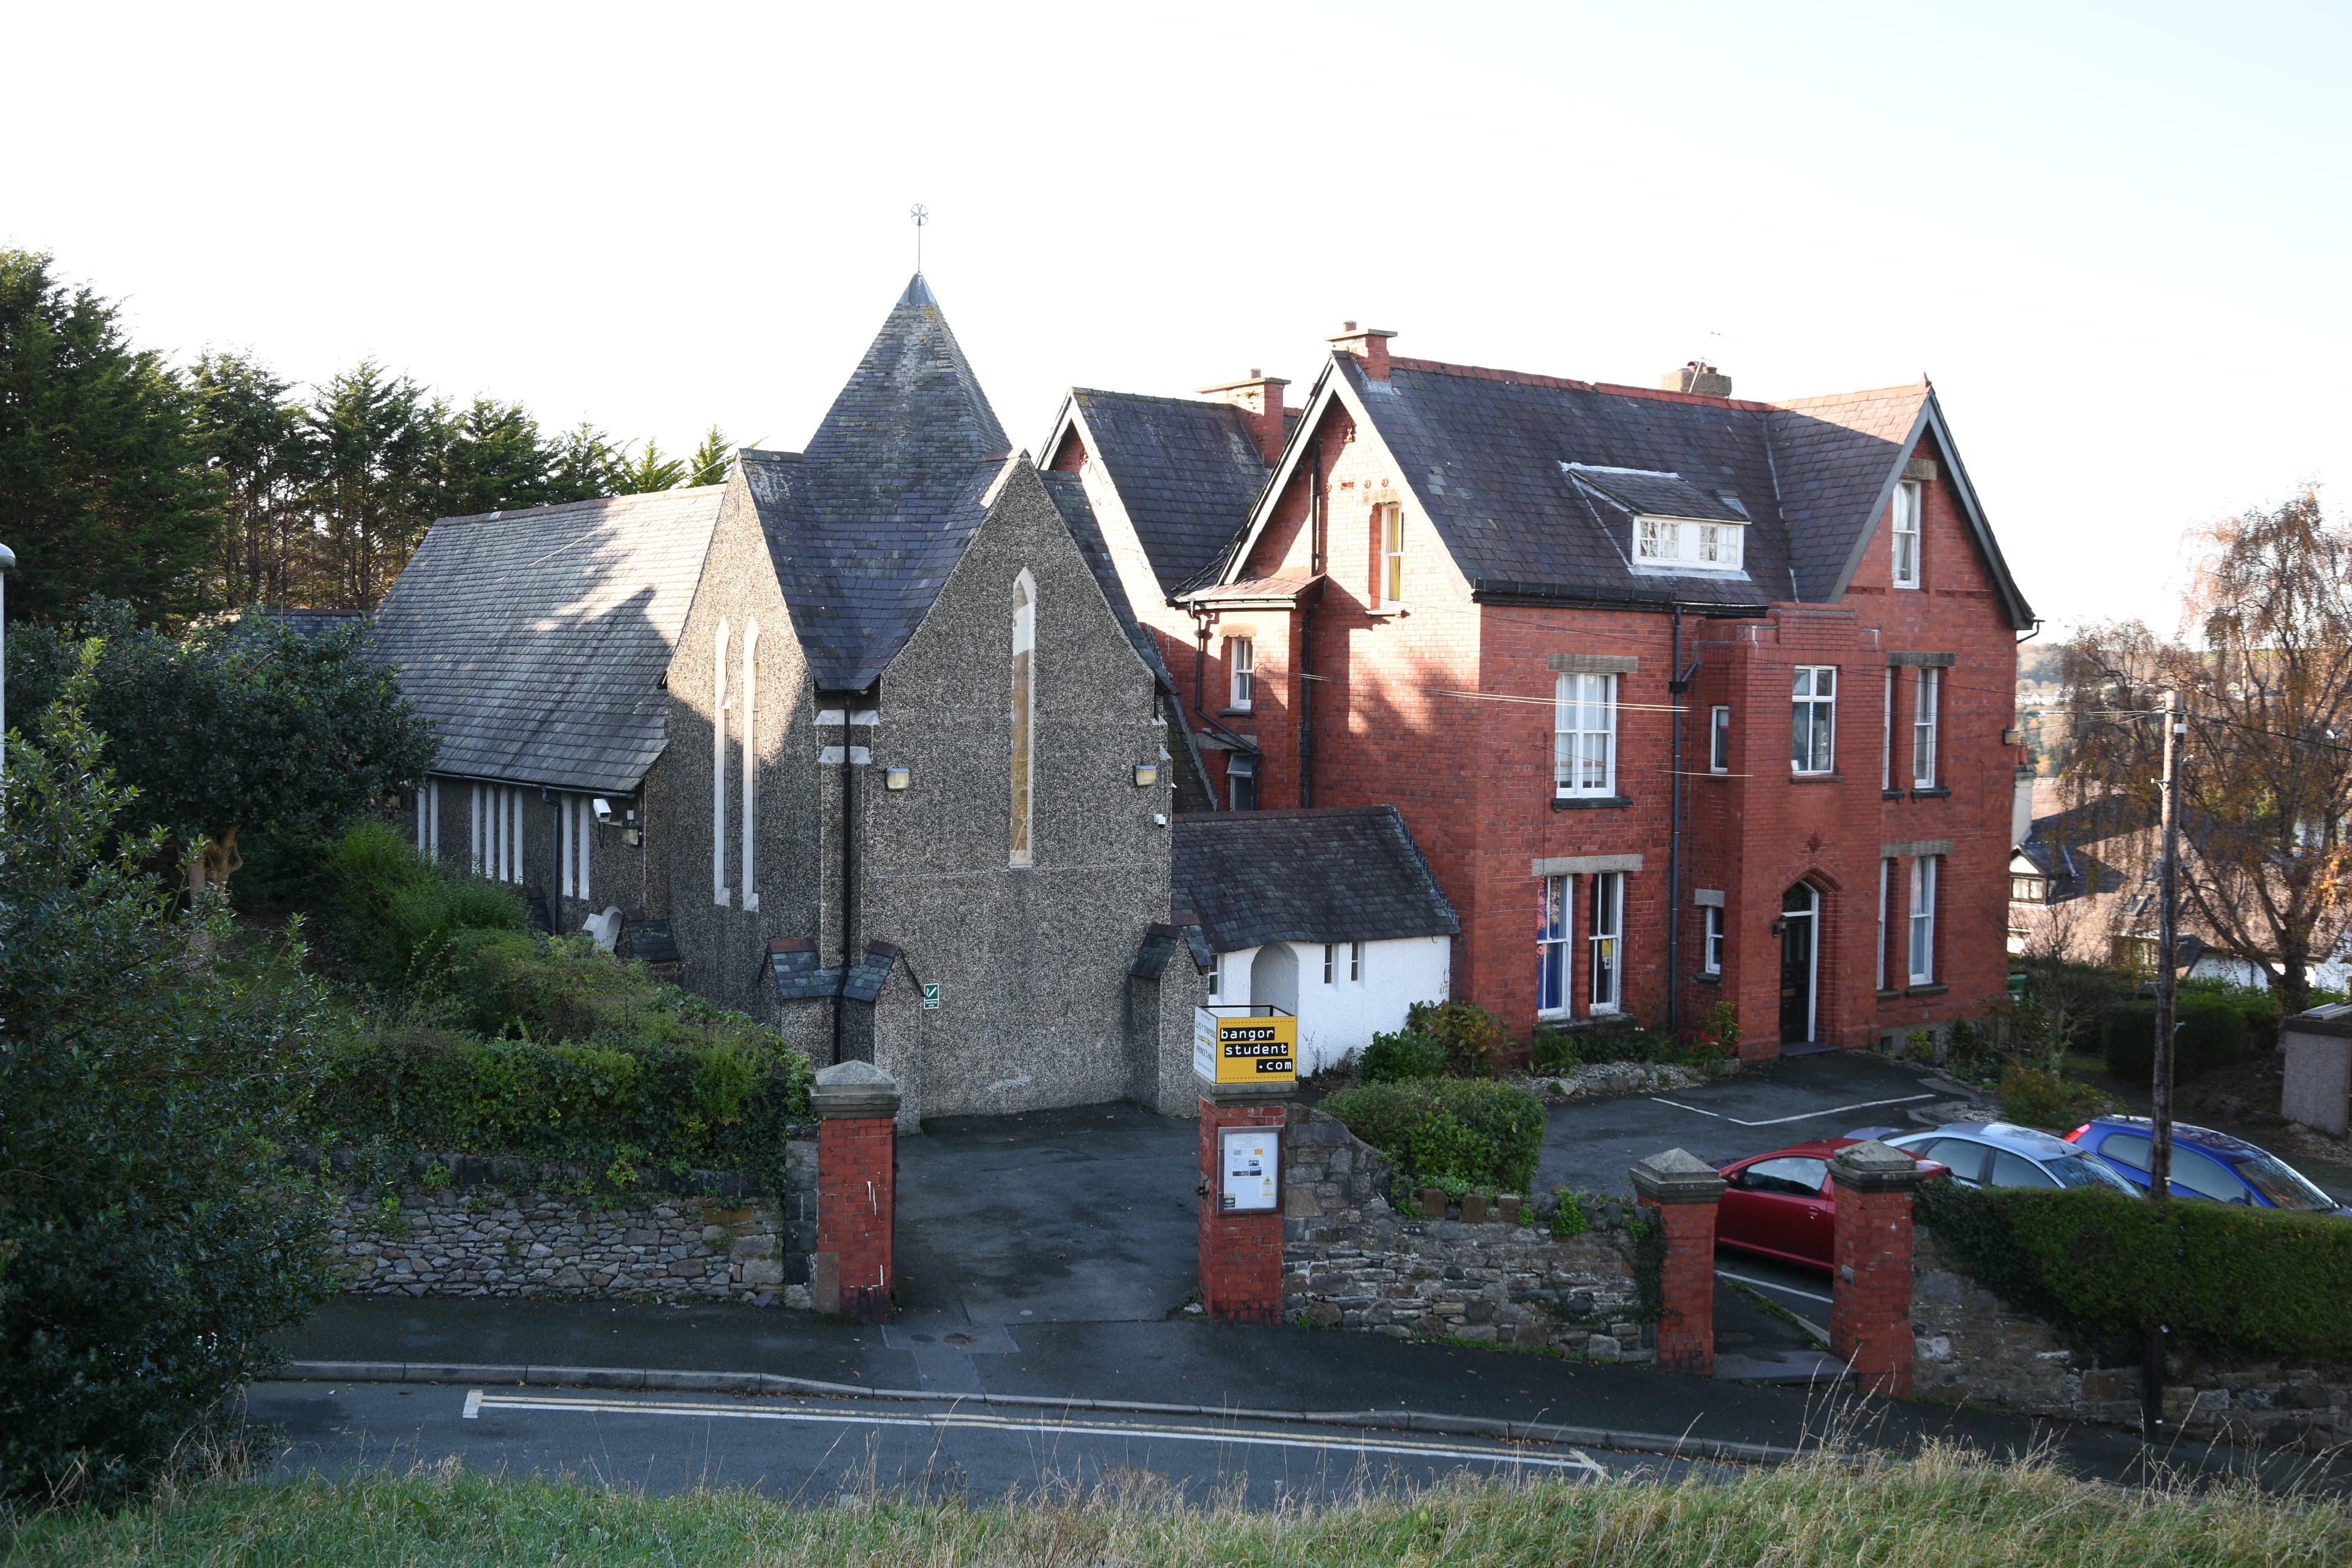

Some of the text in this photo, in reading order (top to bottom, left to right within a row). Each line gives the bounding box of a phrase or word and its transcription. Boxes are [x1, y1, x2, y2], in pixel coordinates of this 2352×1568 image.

[1221, 1028, 1274, 1041] bangor
[1226, 1043, 1287, 1055] student
[1259, 1061, 1292, 1071] .com
